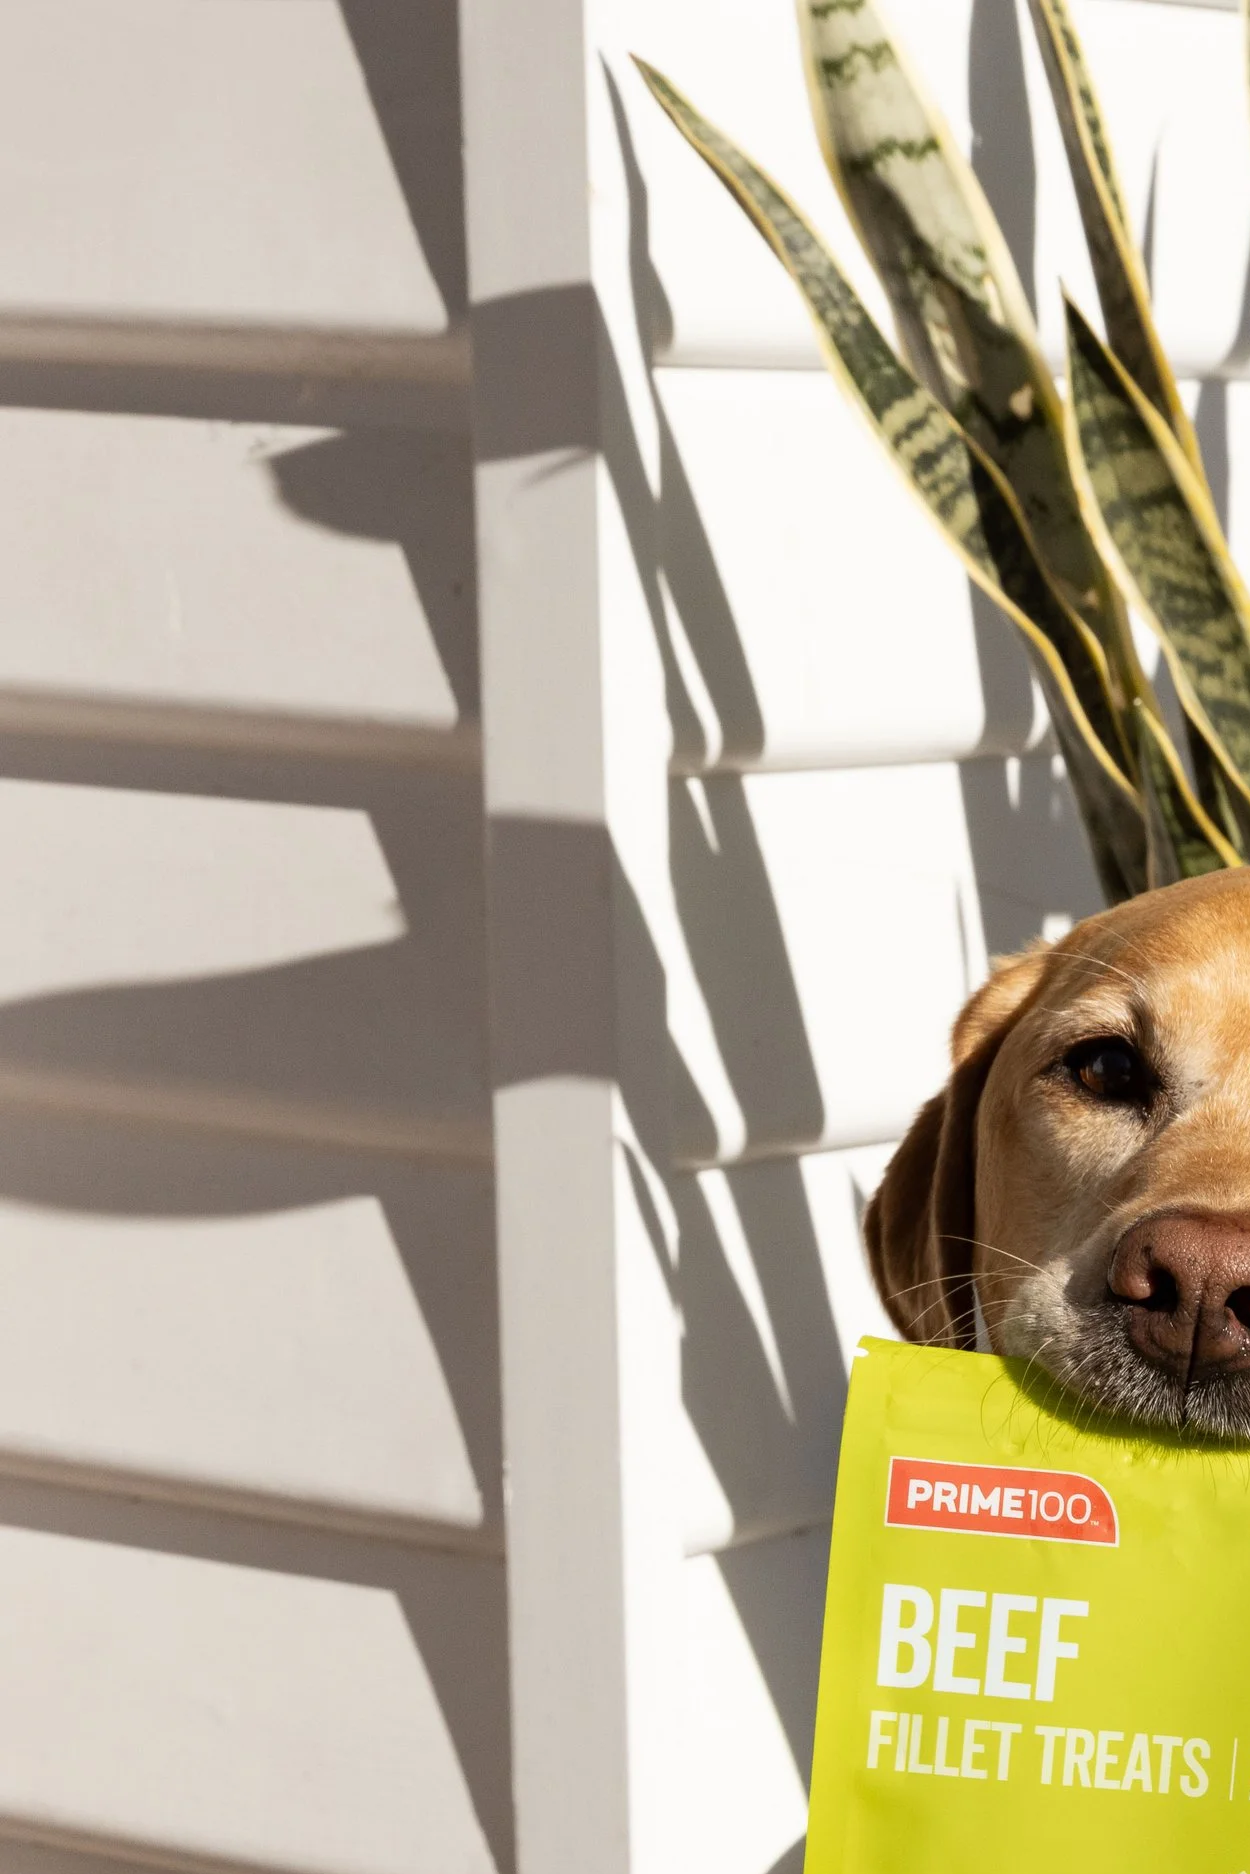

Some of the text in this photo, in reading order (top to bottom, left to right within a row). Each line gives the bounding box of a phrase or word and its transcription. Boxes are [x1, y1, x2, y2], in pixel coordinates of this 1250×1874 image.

[907, 1478, 1092, 1525] PRIME100
[876, 1583, 1090, 1703] BEEF
[866, 1709, 1212, 1798] FILLET TREATS
